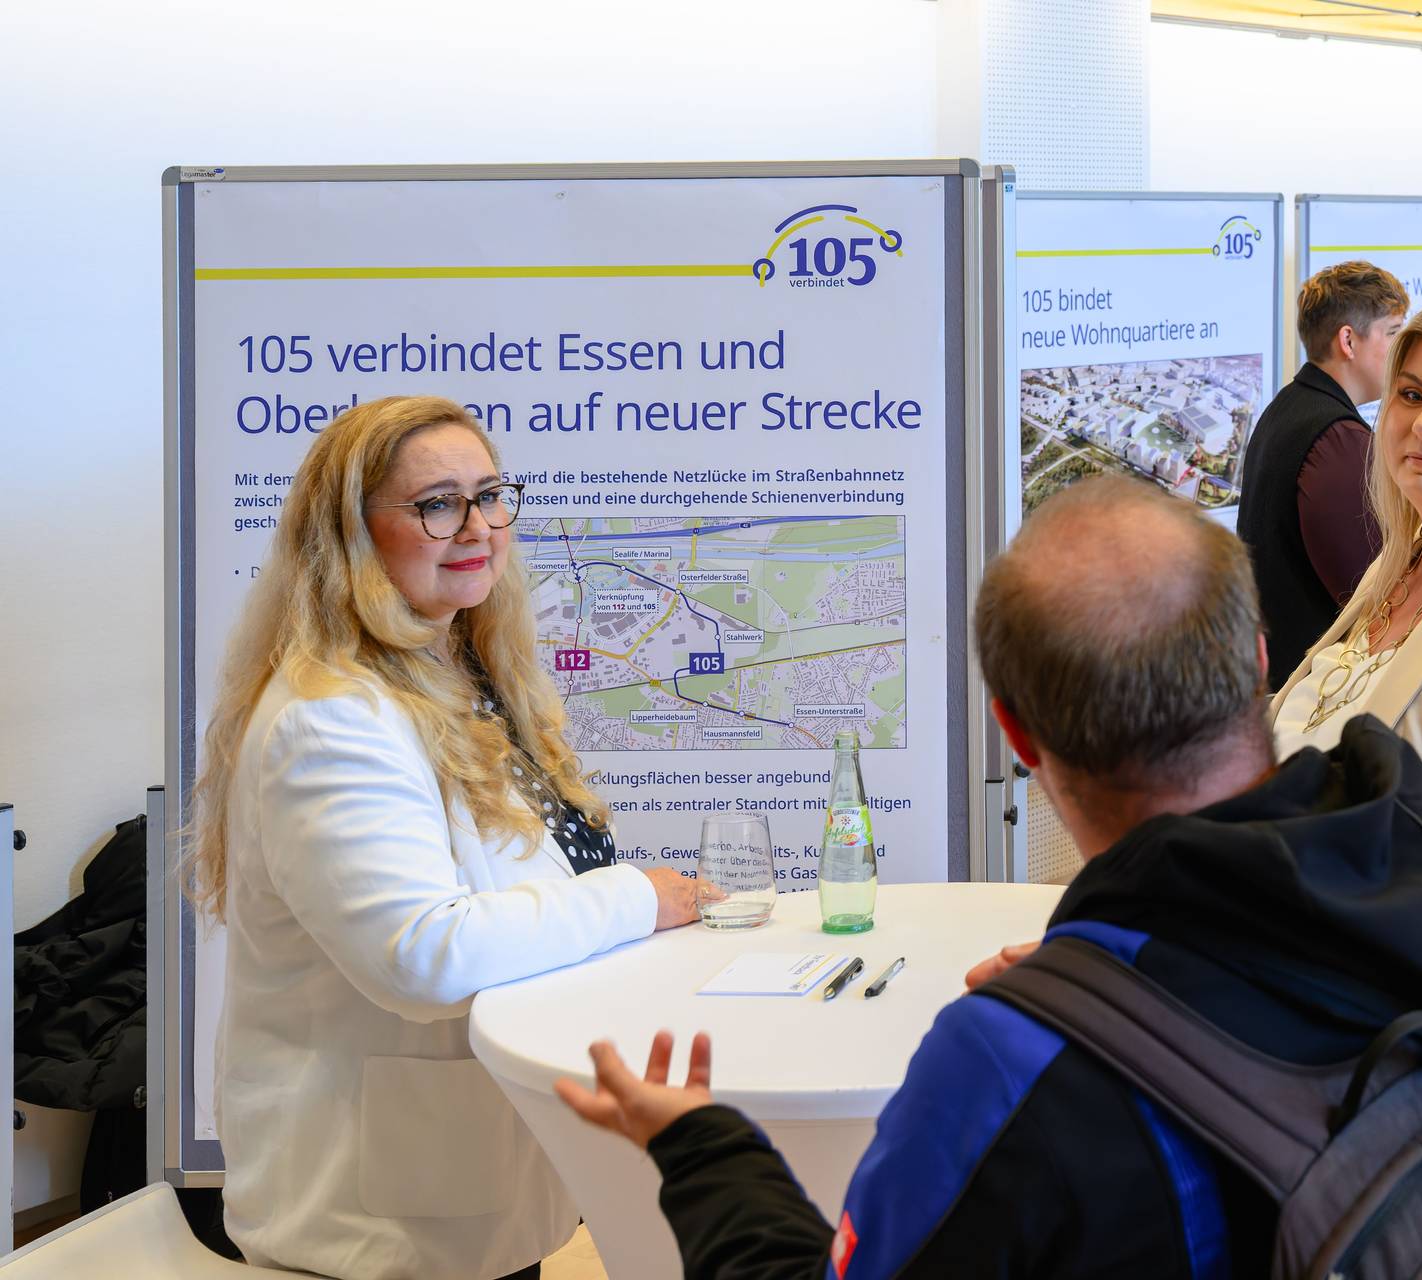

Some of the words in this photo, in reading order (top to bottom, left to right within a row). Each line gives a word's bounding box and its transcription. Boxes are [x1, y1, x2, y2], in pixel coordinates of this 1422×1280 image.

[1224, 233, 1254, 259] 105
[789, 237, 877, 286] 105
[789, 277, 845, 288] verbindet
[1022, 289, 1053, 313] 105
[1058, 287, 1113, 312] bindet
[1021, 328, 1066, 349] neue
[1071, 319, 1195, 350] Wohnquartiere
[1199, 321, 1219, 339] an
[237, 335, 313, 374] 105
[327, 332, 542, 374] verbindet
[559, 333, 682, 372] Essen
[700, 330, 786, 371] und
[529, 393, 604, 432] auf
[617, 398, 747, 432] neuer
[761, 390, 922, 431] Strecke
[234, 473, 259, 486] Mit
[514, 471, 548, 484] wird
[552, 470, 575, 484] die
[580, 470, 668, 483] bestehende
[673, 469, 747, 483] Netzlücke
[752, 469, 771, 482] im
[775, 468, 905, 482] Straßenbahnnetz
[234, 493, 283, 507] zwisch
[522, 491, 568, 505] lossen
[572, 491, 601, 505] und
[605, 492, 636, 505] eine
[640, 491, 748, 508] durchgehende
[751, 489, 905, 506] Schienenverbindung
[234, 514, 278, 531] gesch
[614, 550, 639, 558] Sealife
[643, 550, 670, 558] Marina
[528, 562, 568, 570] Gasometer
[680, 573, 722, 581] Osterfelder
[722, 573, 747, 581] Straße
[596, 592, 645, 601] Verknüpfung
[726, 633, 763, 641] Stahlwerk
[557, 653, 586, 667] 112
[692, 657, 721, 671] 105
[631, 713, 696, 722] Lipperheidebaum
[703, 730, 761, 738] Hausmannsfeld
[586, 771, 702, 788] icklungsflächen
[704, 771, 753, 785] besser
[756, 770, 831, 787] angebund
[642, 798, 662, 811] als
[666, 798, 732, 811] zentraler
[735, 797, 799, 811] Standort
[803, 797, 828, 810] mit
[616, 846, 657, 861] aufs-,
